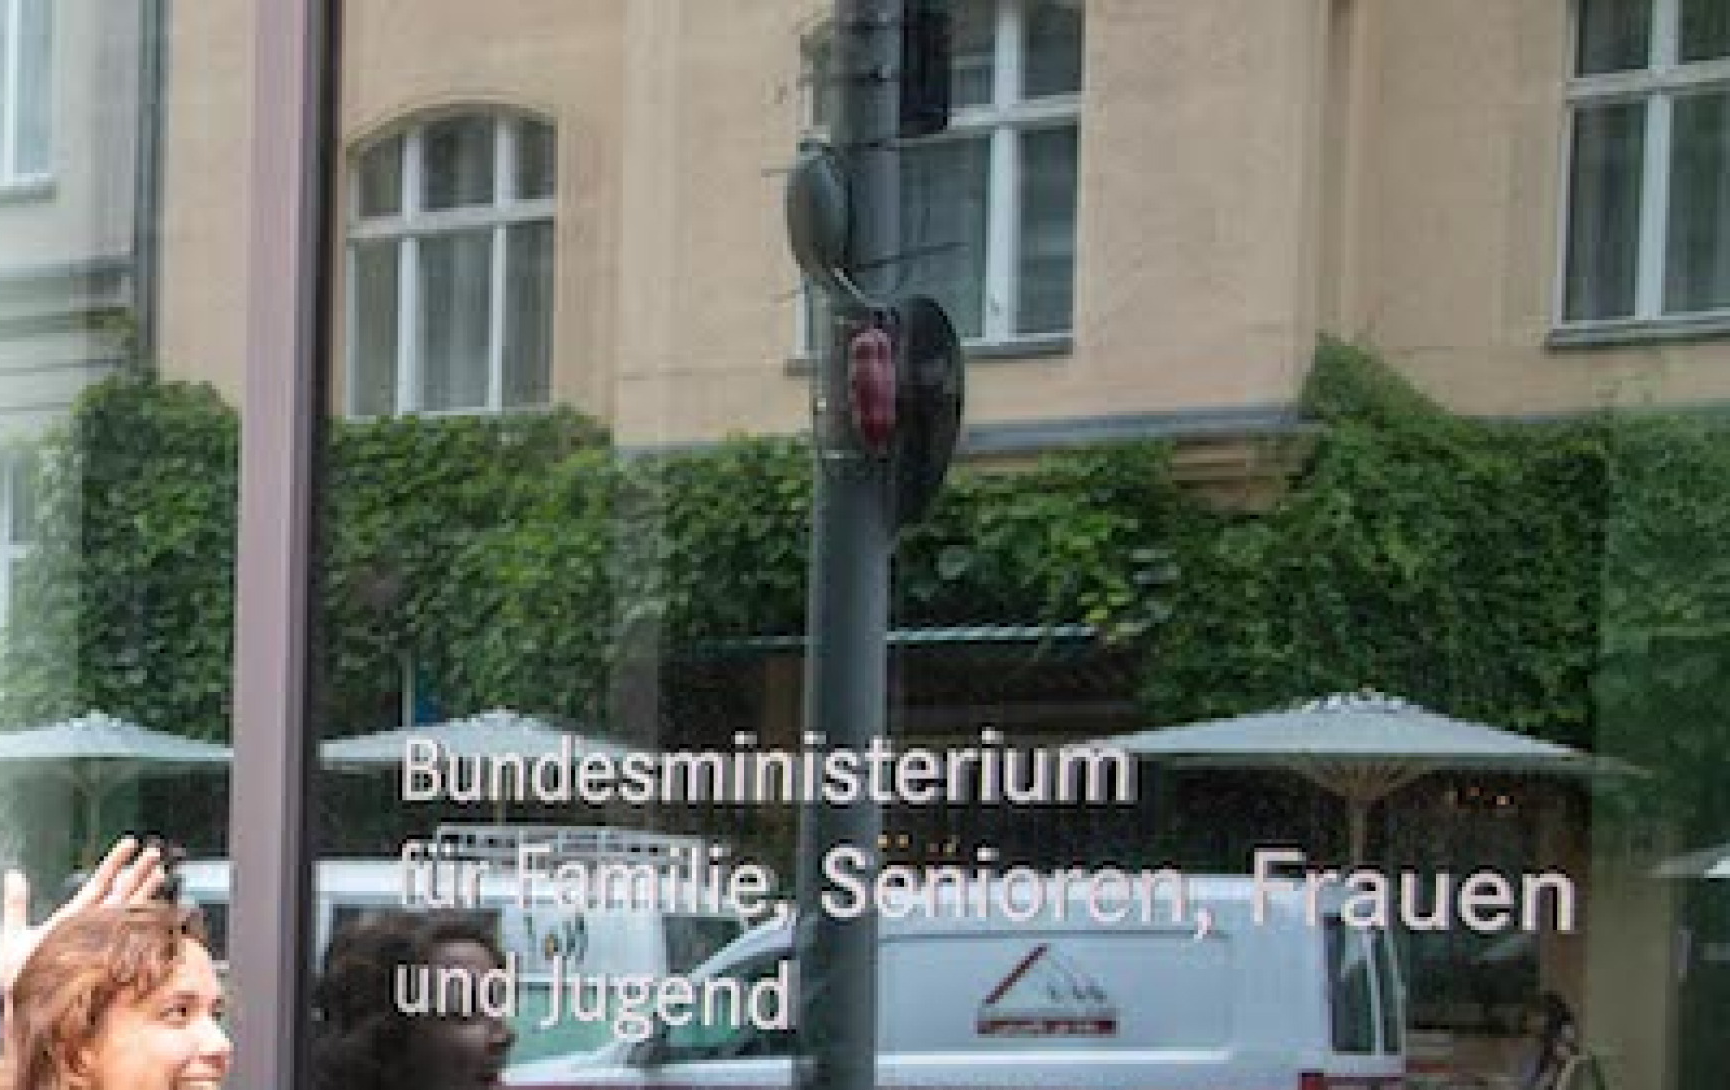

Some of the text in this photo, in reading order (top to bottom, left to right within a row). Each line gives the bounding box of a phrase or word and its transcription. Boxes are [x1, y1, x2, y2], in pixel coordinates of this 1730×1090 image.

[400, 730, 1135, 803] Bundesministerium
[399, 838, 1576, 942] für Familie, Senioren, Frauen
[394, 952, 790, 1039] und Jugend
